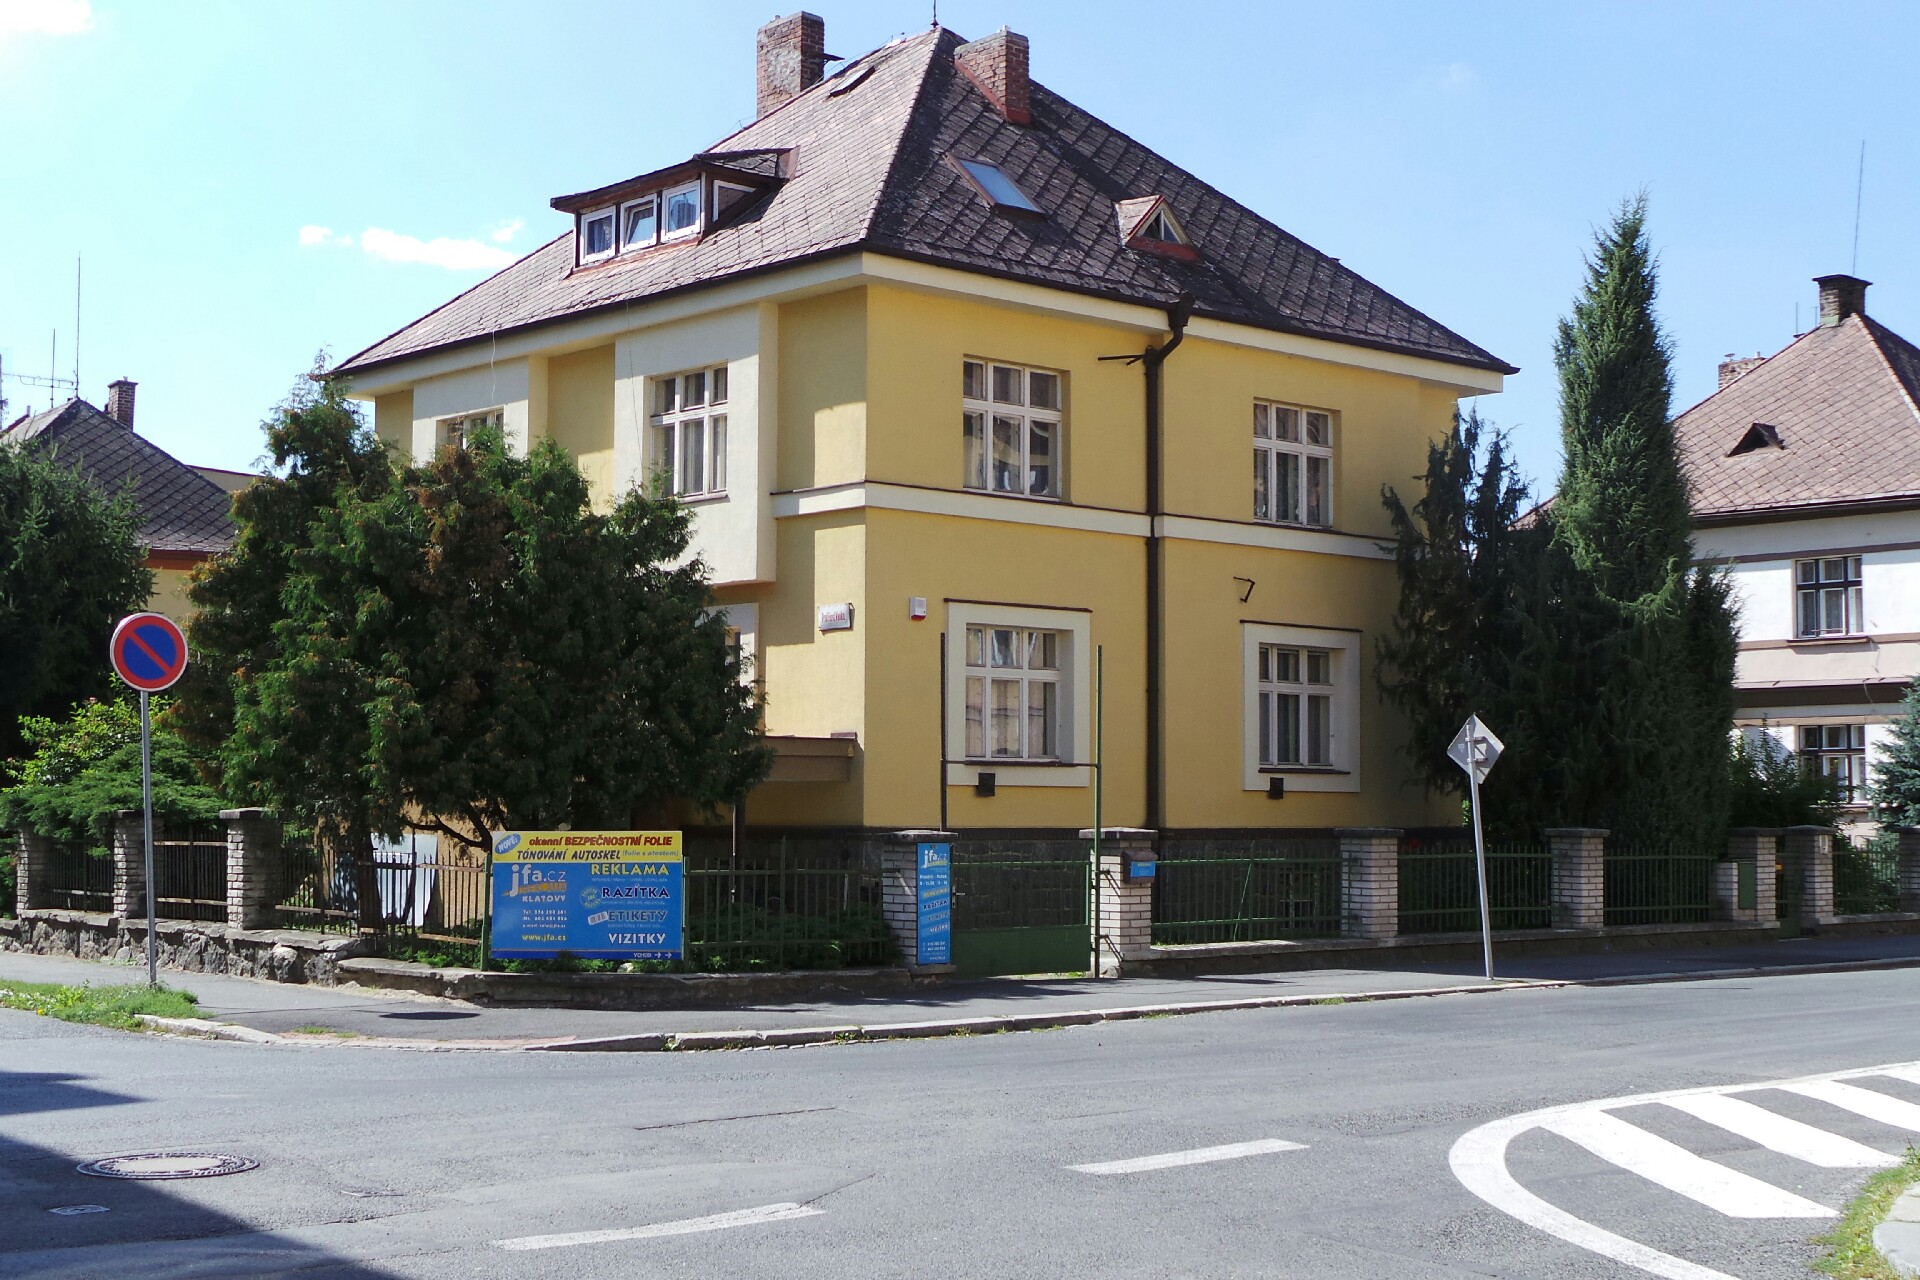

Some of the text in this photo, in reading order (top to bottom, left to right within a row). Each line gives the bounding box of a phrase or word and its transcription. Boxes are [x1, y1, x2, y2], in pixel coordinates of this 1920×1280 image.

[528, 834, 673, 846] okenní BEZPEČNOSTNÍ FOLIE
[517, 848, 568, 860] TÓNOVÁNÍ
[571, 849, 621, 861] AUTOSKEL
[591, 864, 669, 875] REKLAMA
[602, 884, 670, 898] RAZÍTKA
[608, 910, 667, 922] ETIKETY
[521, 934, 567, 942] www.jfa.cz
[608, 933, 667, 945] VIZITKY
